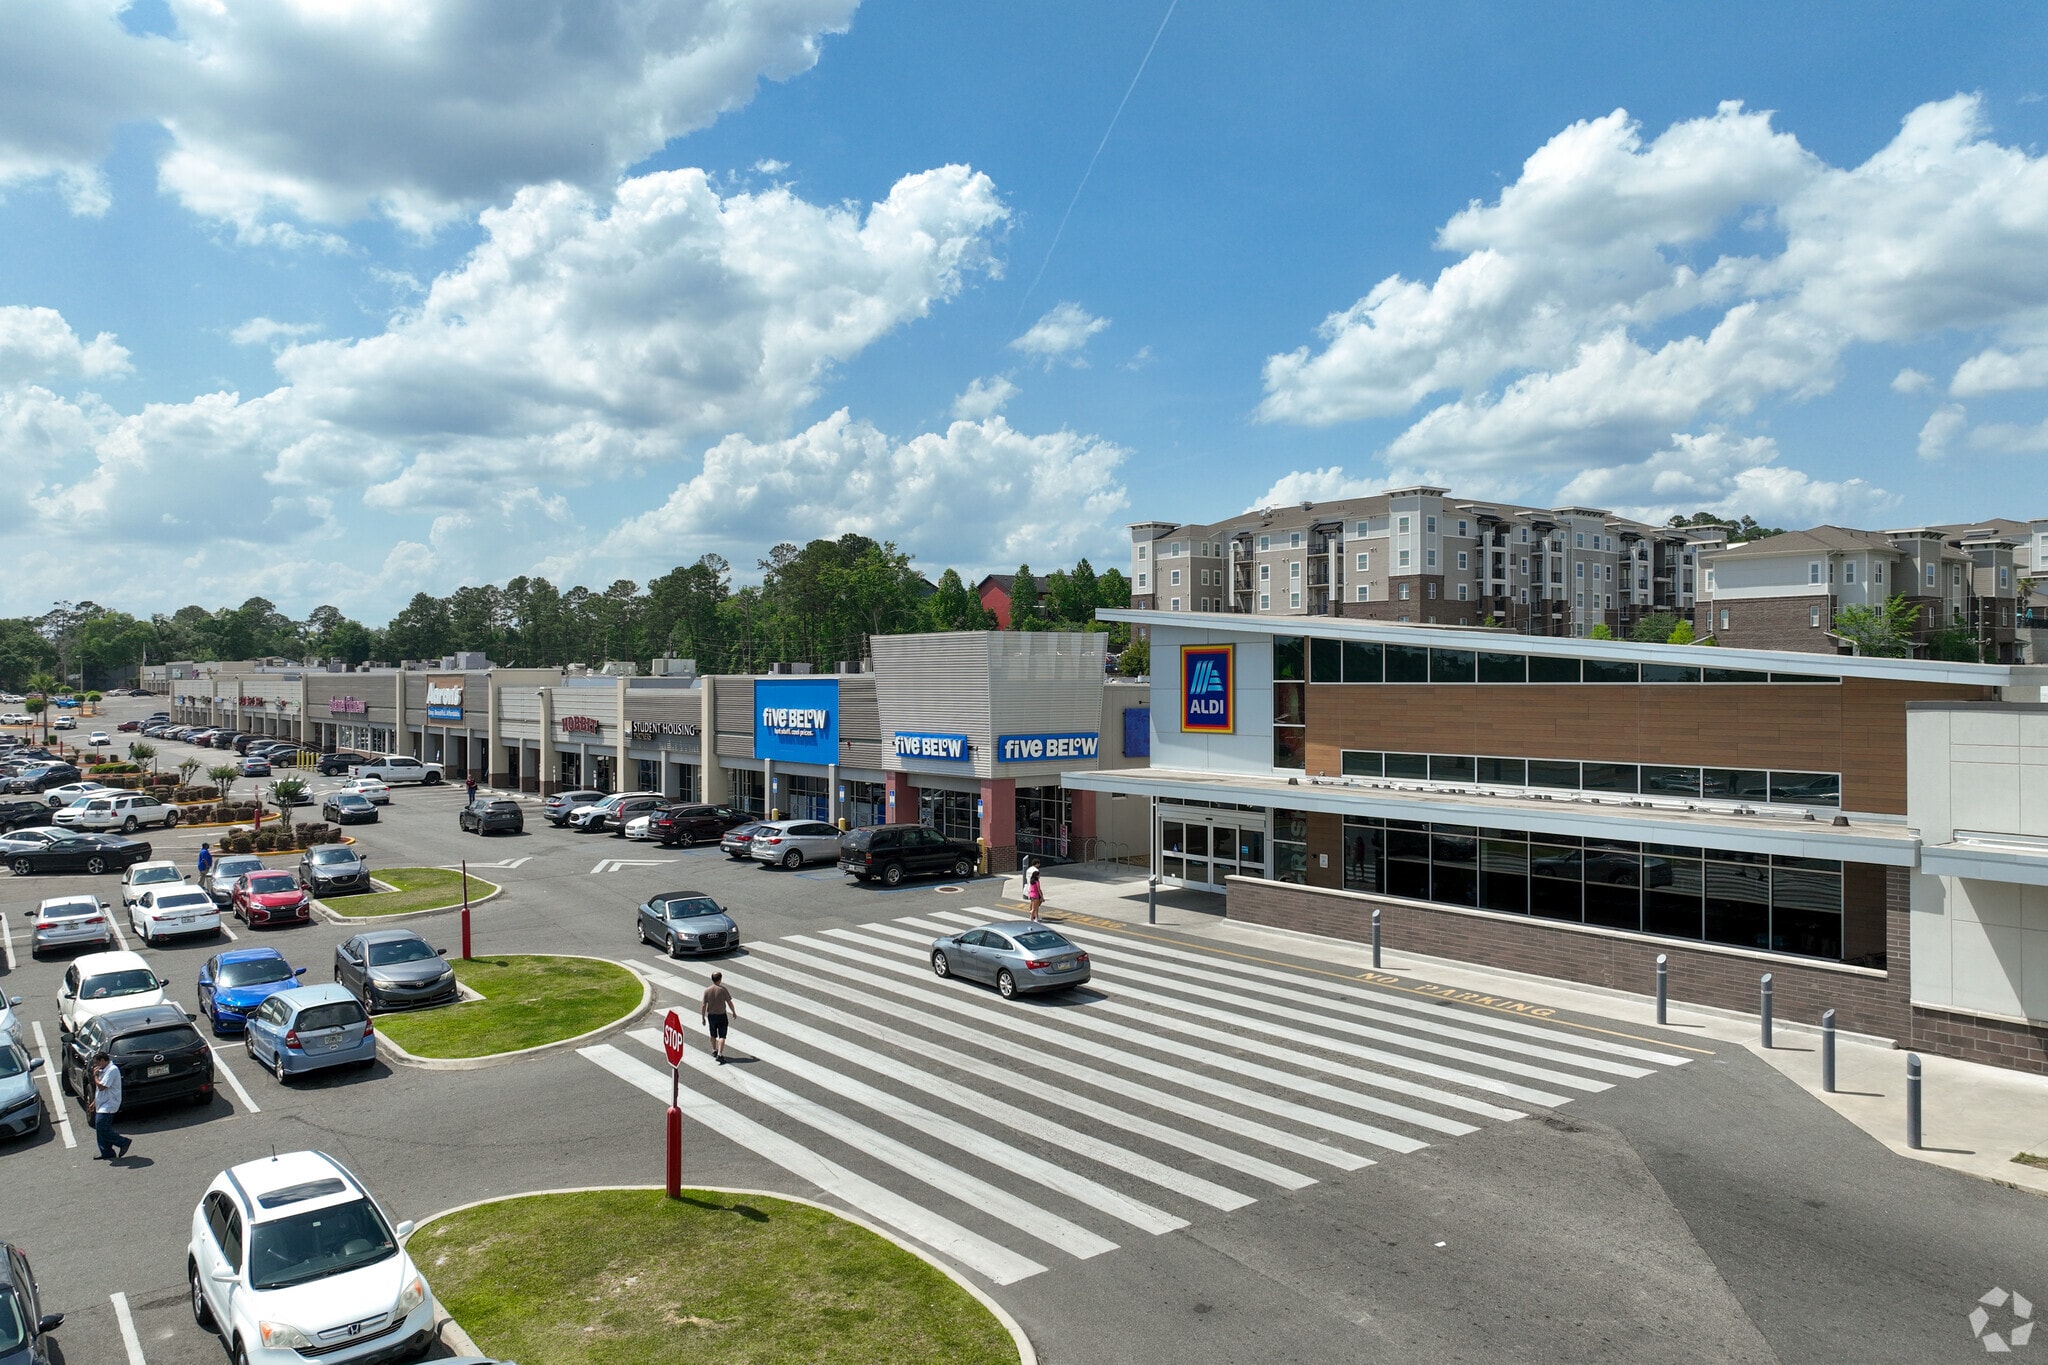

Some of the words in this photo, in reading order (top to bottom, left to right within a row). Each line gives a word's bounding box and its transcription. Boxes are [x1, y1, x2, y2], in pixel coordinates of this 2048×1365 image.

[1190, 699, 1224, 714] ALDI
[561, 715, 597, 734] HOBBIT
[763, 707, 788, 727] five
[633, 721, 661, 734] STUDENT
[663, 723, 695, 736] HOUSING
[895, 736, 920, 755] five
[1005, 739, 1043, 759] five
[1356, 972, 1399, 985] NO
[1414, 984, 1559, 1018] PARKING
[664, 1024, 683, 1052] STOP
